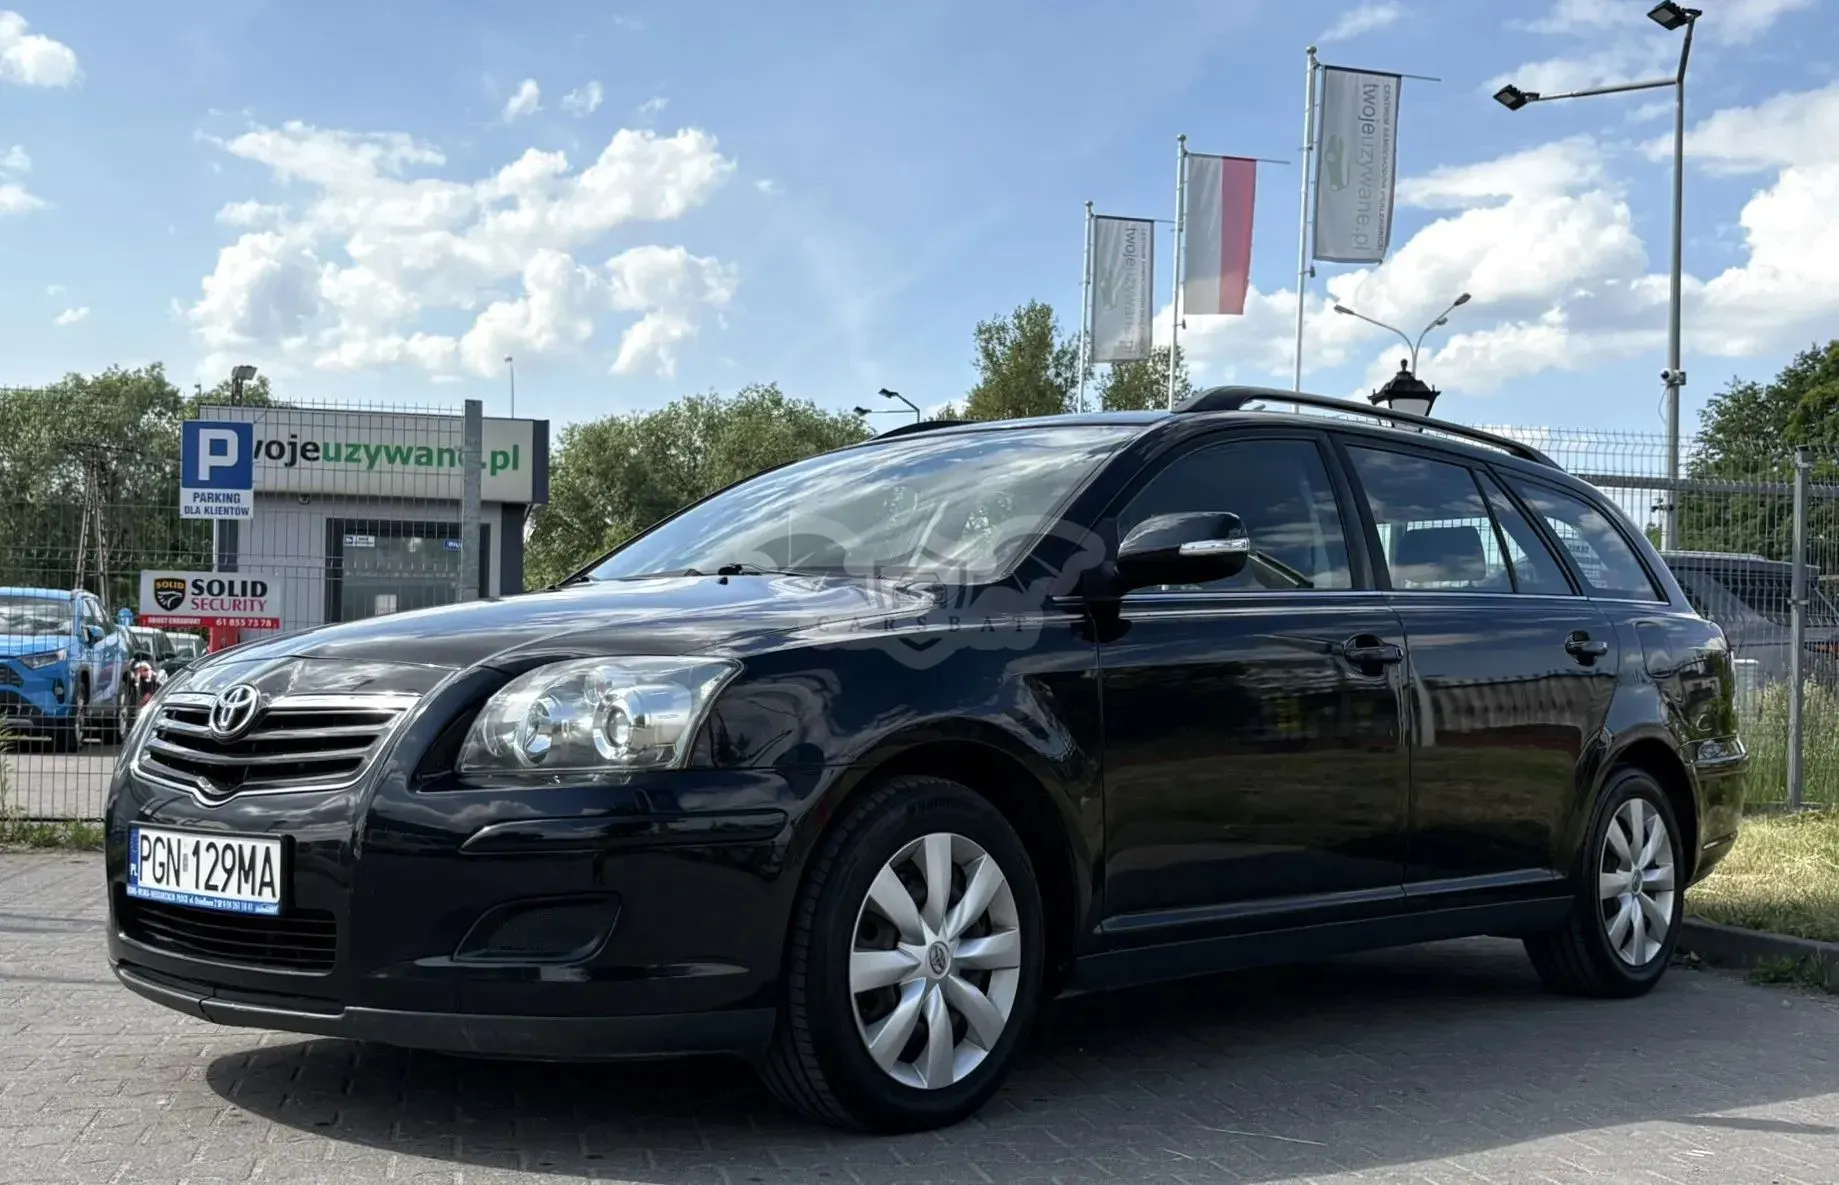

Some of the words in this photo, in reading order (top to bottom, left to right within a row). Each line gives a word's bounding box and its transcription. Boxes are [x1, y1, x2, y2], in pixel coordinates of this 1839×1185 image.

[1352, 84, 1379, 250] twojeuzywane.pl
[198, 429, 239, 481] P
[253, 434, 519, 476] ojeuzywan.pl
[193, 491, 241, 504] PARKING
[184, 505, 201, 515] DLA
[203, 505, 249, 516] KLIENTÓW
[156, 580, 184, 590] SOLID
[191, 579, 268, 598] SOLID
[191, 597, 267, 612] SECURITY
[216, 618, 227, 627] 61
[130, 863, 138, 876] PL
[140, 834, 181, 887] PGN
[192, 839, 277, 898] 129MA
